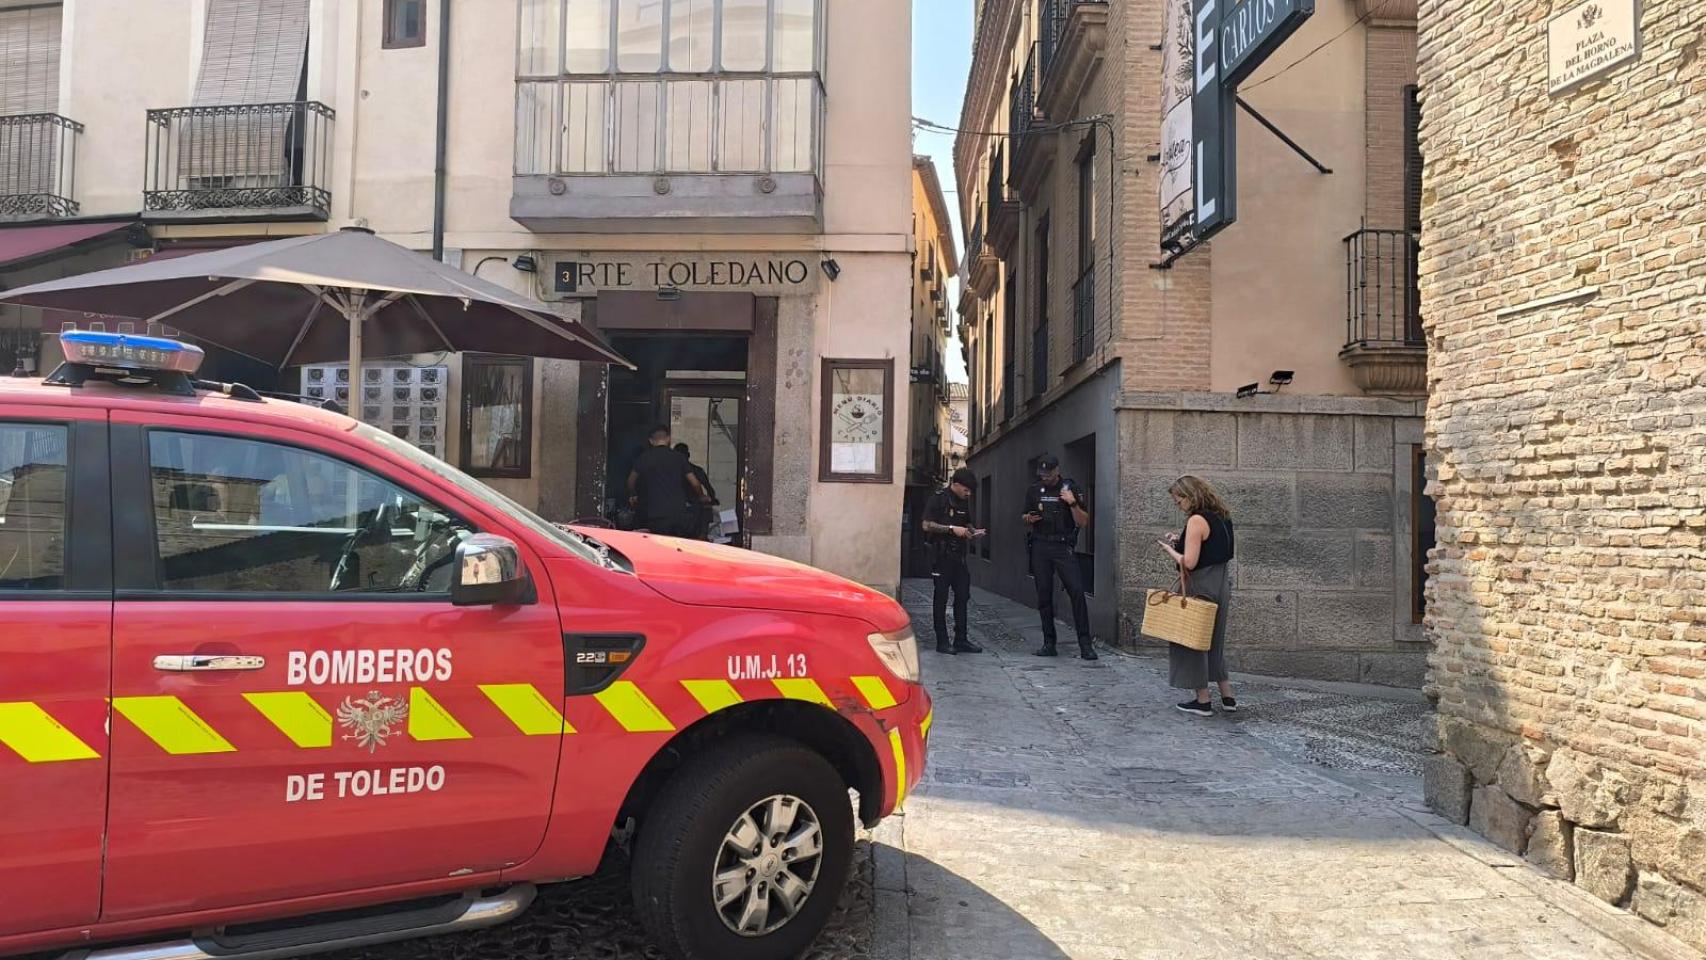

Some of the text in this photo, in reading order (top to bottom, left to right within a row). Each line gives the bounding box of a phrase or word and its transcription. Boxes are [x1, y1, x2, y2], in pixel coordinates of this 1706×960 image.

[1565, 37, 1616, 69] DEL HORNO
[1576, 31, 1604, 51] PLAZA
[1550, 42, 1633, 89] DE LA MAGDALENA
[562, 271, 570, 283] 3
[577, 260, 807, 286] RTE TOLEDANO
[287, 648, 452, 685] BOMBEROS
[727, 653, 807, 680] U.M.J. 13
[286, 765, 445, 801] DE TOLEDO
